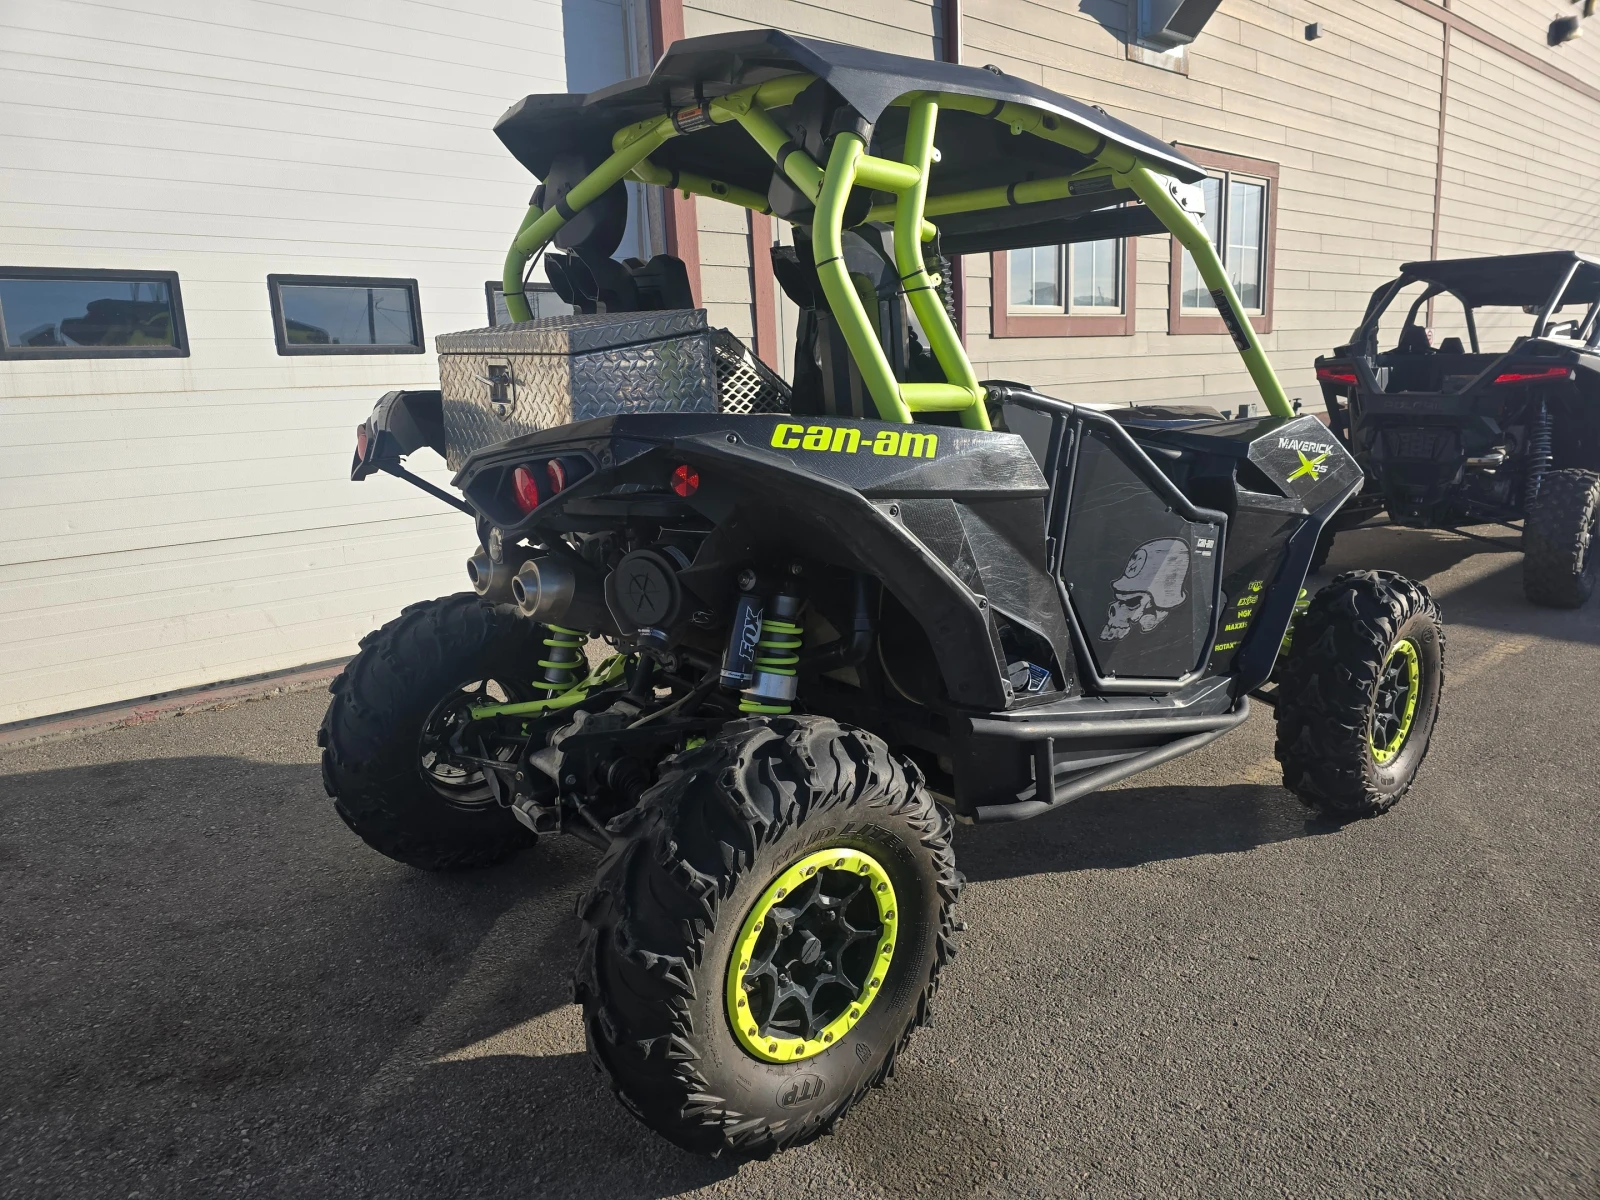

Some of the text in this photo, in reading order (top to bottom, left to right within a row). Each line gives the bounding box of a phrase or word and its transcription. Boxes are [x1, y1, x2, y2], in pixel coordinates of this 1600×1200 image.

[770, 423, 938, 459] can-am
[1278, 437, 1334, 455] MAVERICK
[1237, 608, 1252, 618] NGK
[739, 605, 764, 662] FOX
[1224, 621, 1248, 631] MAXXIS
[782, 1078, 824, 1106] ITP
